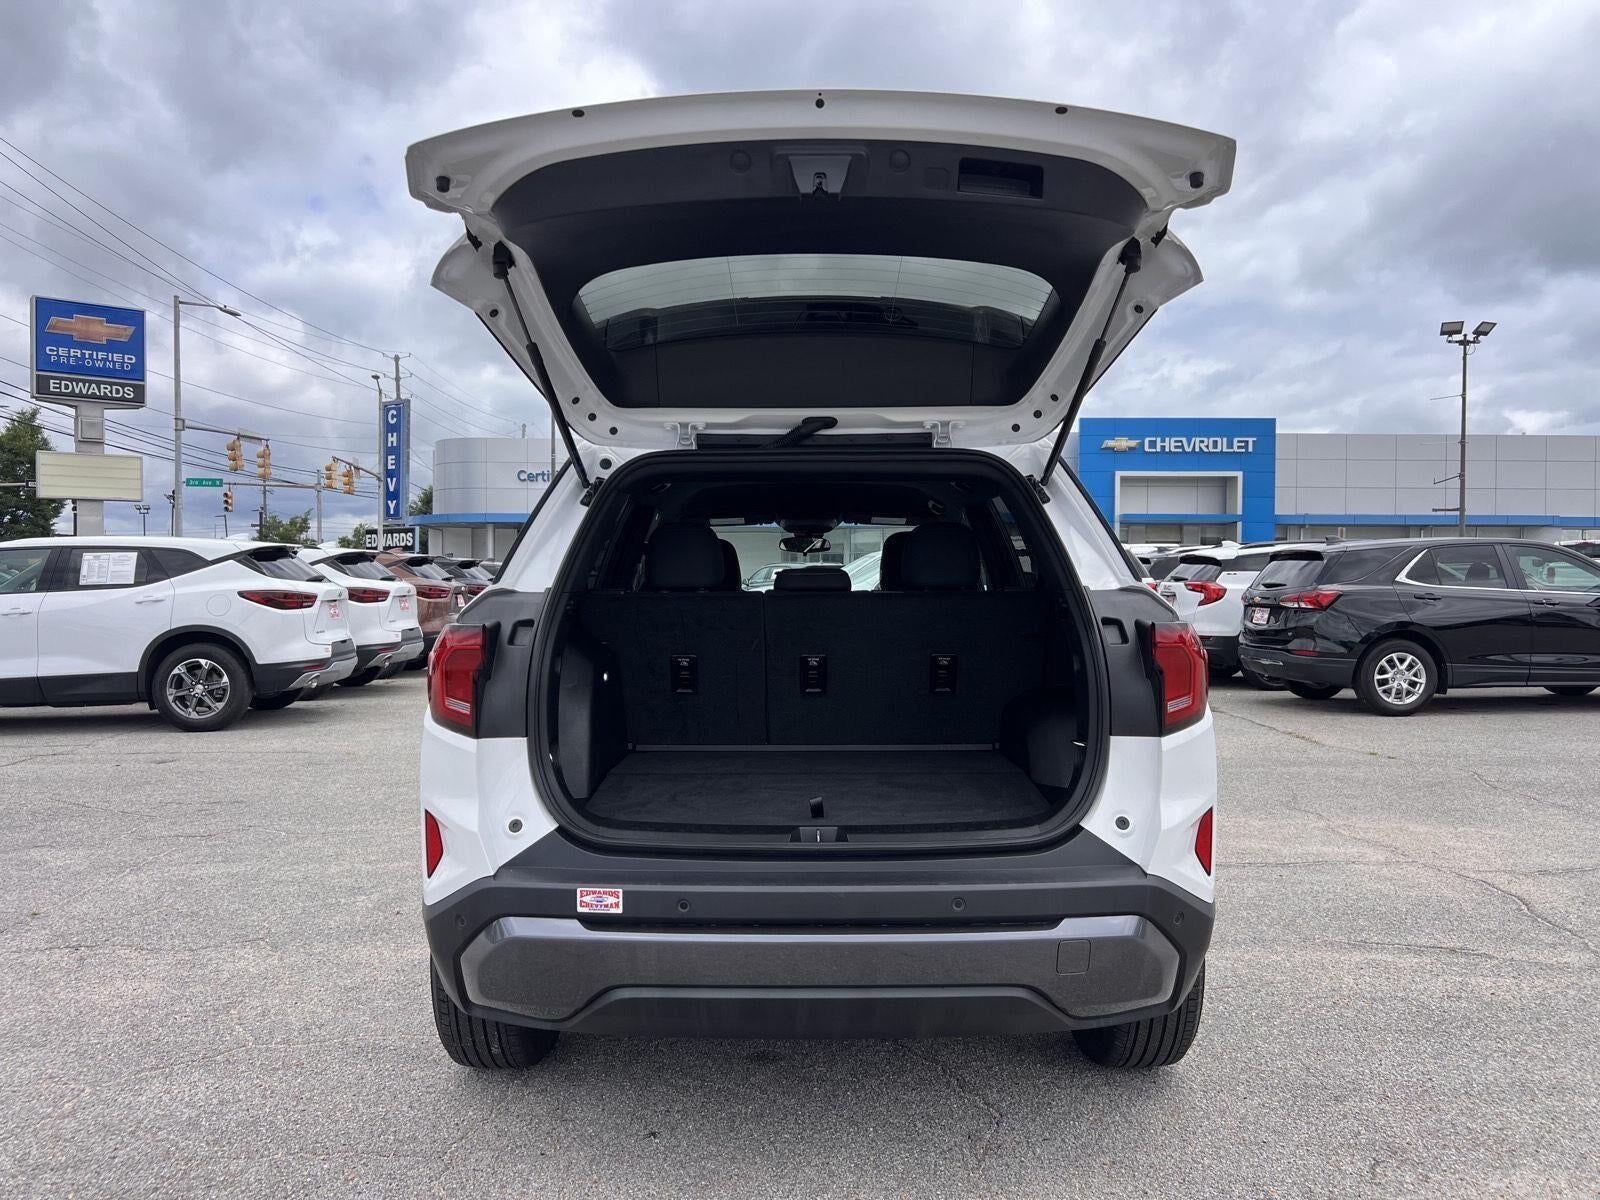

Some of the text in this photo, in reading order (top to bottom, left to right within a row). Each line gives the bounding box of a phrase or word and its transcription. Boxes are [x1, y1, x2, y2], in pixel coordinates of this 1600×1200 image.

[46, 346, 136, 364] CERTIFIED
[51, 356, 131, 371] PRE-OWNED
[50, 380, 135, 399] EDWARDS
[1144, 437, 1257, 452] CHEVROLET
[387, 410, 397, 514] CHEVY
[517, 470, 559, 482] Certi
[580, 890, 620, 899] EDWARDS
[580, 900, 620, 909] CHEVYMAN
